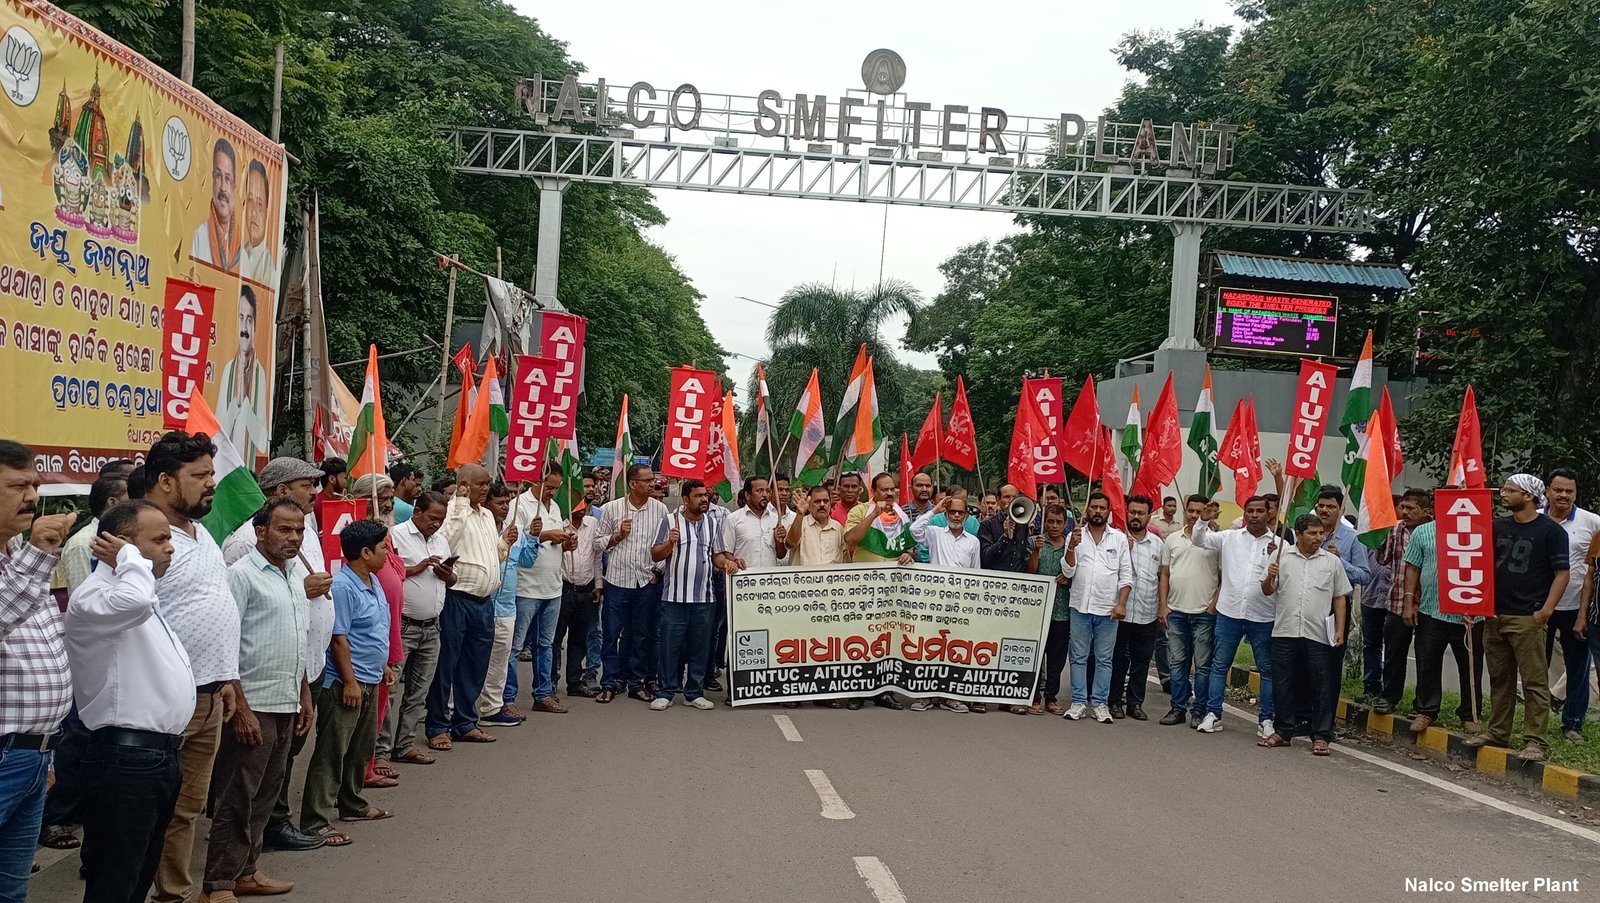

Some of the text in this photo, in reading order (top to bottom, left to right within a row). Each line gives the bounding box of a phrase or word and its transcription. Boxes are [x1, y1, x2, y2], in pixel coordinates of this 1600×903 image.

[514, 73, 1238, 171] NALCO SMELTER PLANT
[53, 280, 65, 307] ଓ
[1223, 292, 1332, 308] HAZARDOUS WASTE GENERATED
[167, 292, 204, 420] AIUTUC
[513, 368, 548, 472] AIUTUC
[669, 377, 705, 469] AIUTUC
[1292, 370, 1327, 469] AIUTUC
[1446, 498, 1483, 604] AIUTUC
[737, 672, 1030, 699] TUCC SEWA AICCTU LPF UTUC FEDERATIONS
[750, 659, 1019, 685] INTUC AITUC HMS CITU AIUTUC
[774, 629, 998, 667] ସାଧାରଣ ଧର୍ମଘଟ
